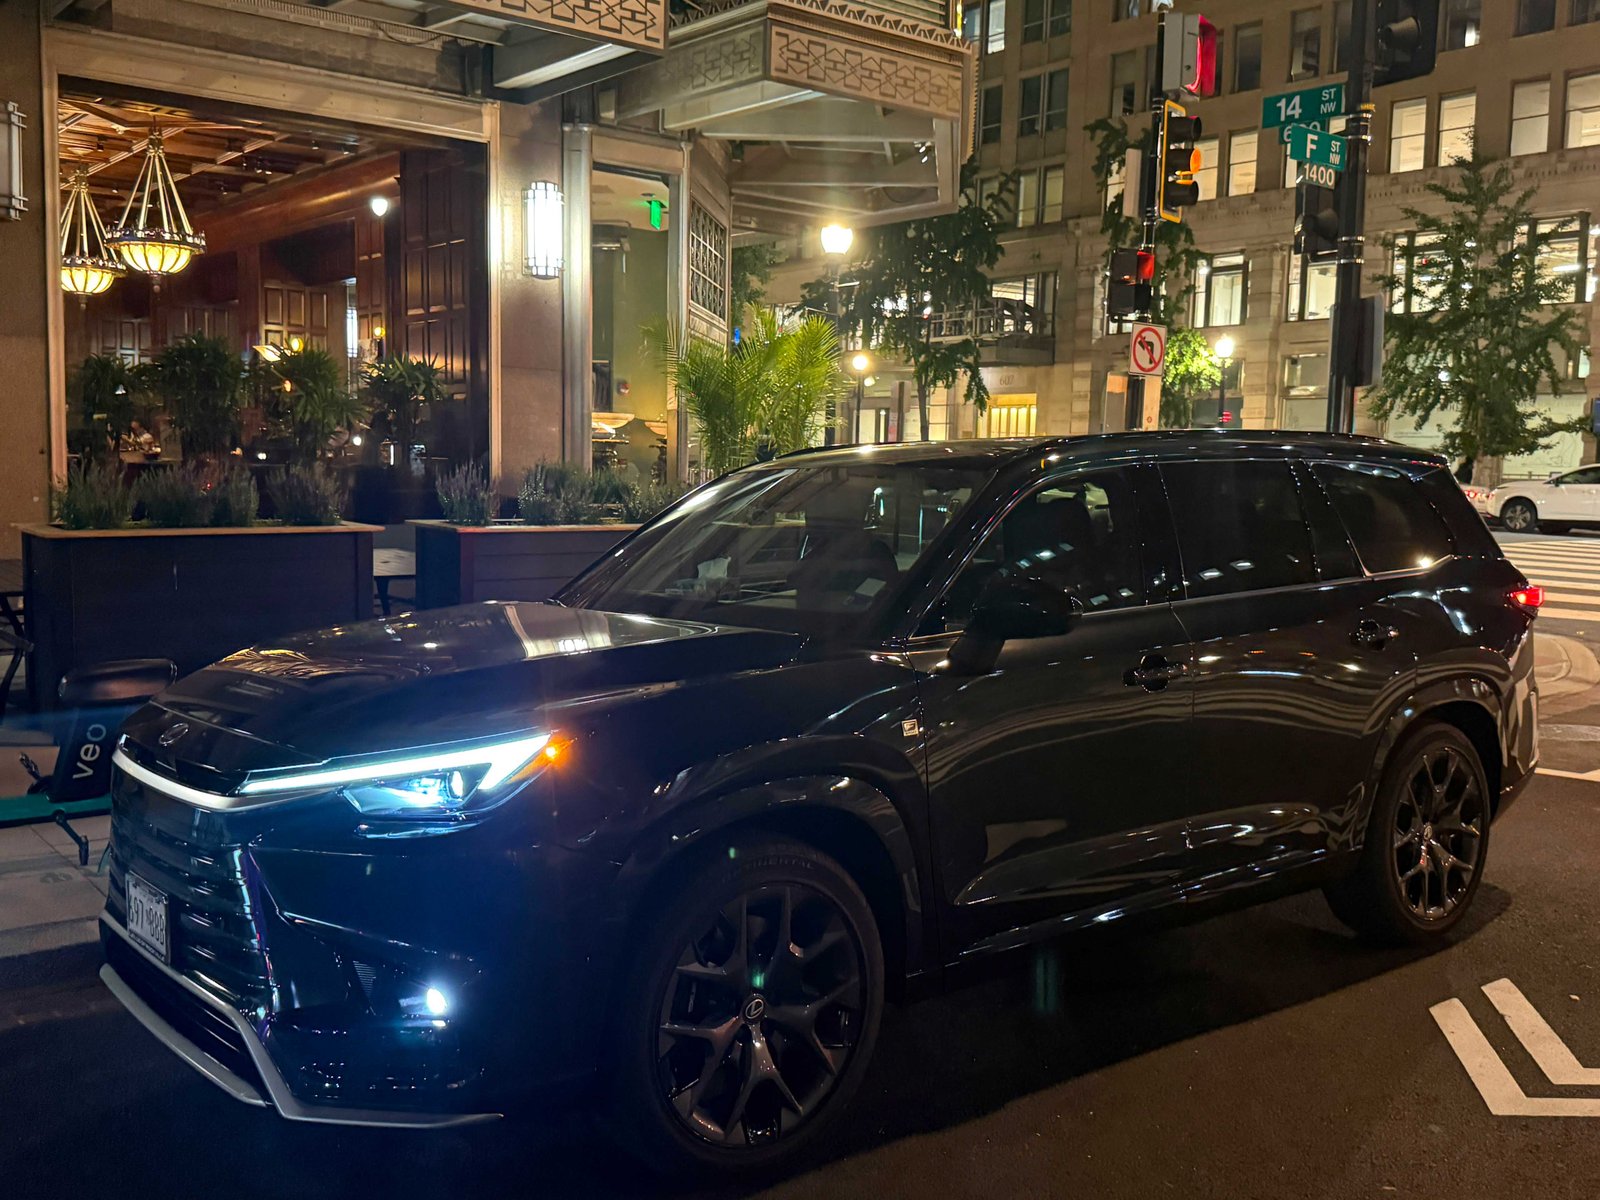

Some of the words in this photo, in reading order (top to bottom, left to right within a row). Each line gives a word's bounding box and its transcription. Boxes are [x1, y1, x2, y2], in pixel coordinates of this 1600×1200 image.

[1276, 95, 1302, 121] 14
[1321, 88, 1337, 101] ST
[1320, 102, 1337, 115] NW
[1305, 133, 1318, 159] F
[1330, 140, 1341, 153] ST
[1329, 153, 1341, 165] NW
[1304, 163, 1335, 186] 1400
[72, 723, 107, 780] veo
